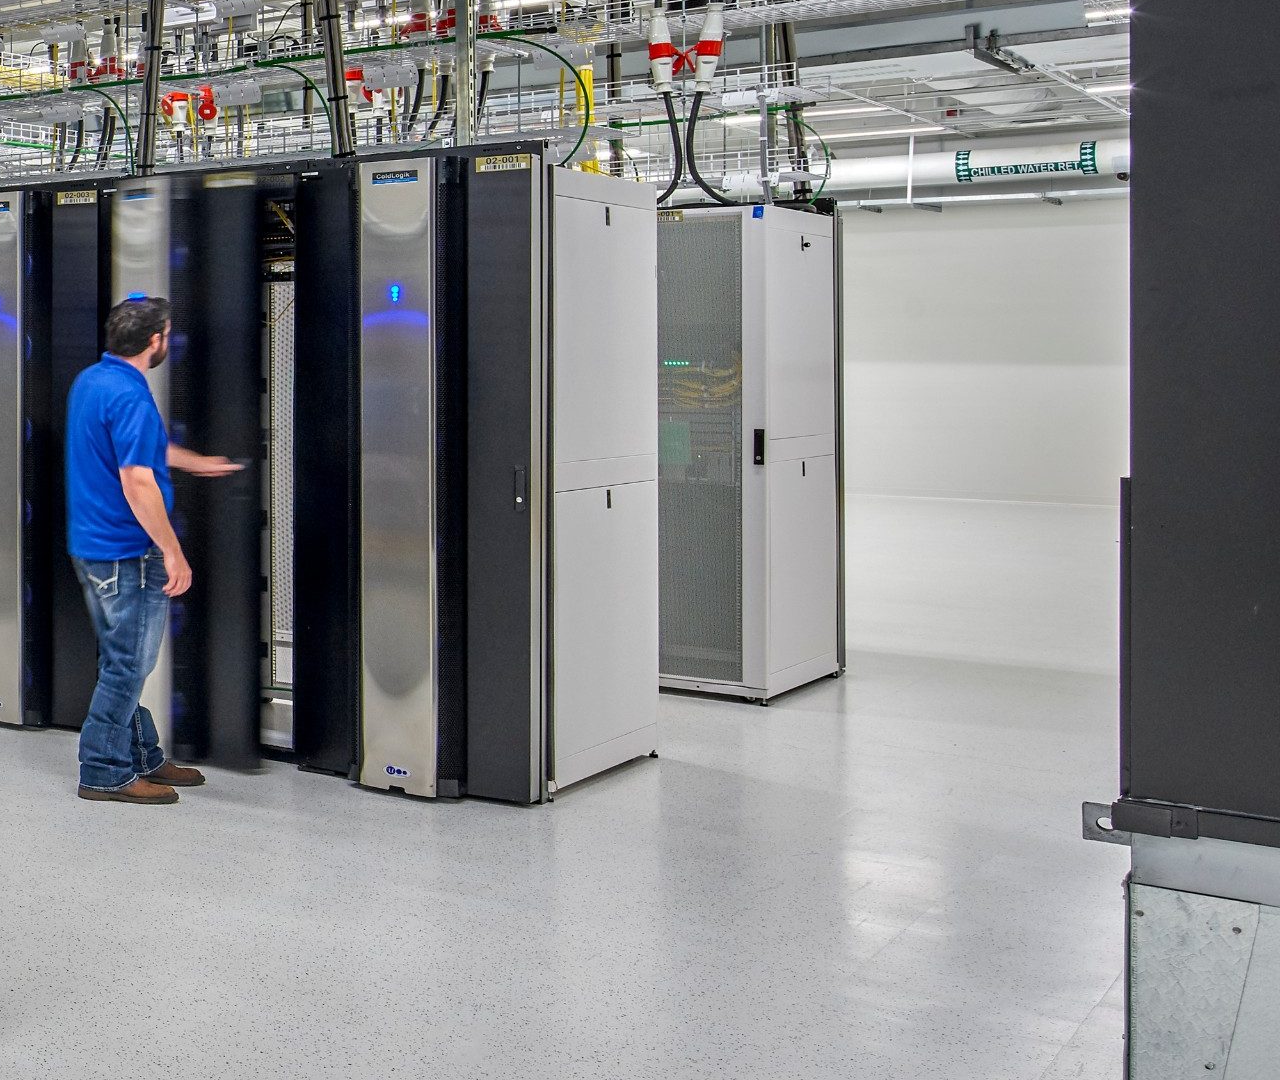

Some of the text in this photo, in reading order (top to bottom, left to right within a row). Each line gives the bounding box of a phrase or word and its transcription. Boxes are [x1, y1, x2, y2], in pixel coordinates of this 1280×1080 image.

[485, 156, 520, 165] 02-001
[971, 166, 1015, 177] CHILLED
[1018, 162, 1056, 174] WATER
[64, 191, 90, 199] 02-003
